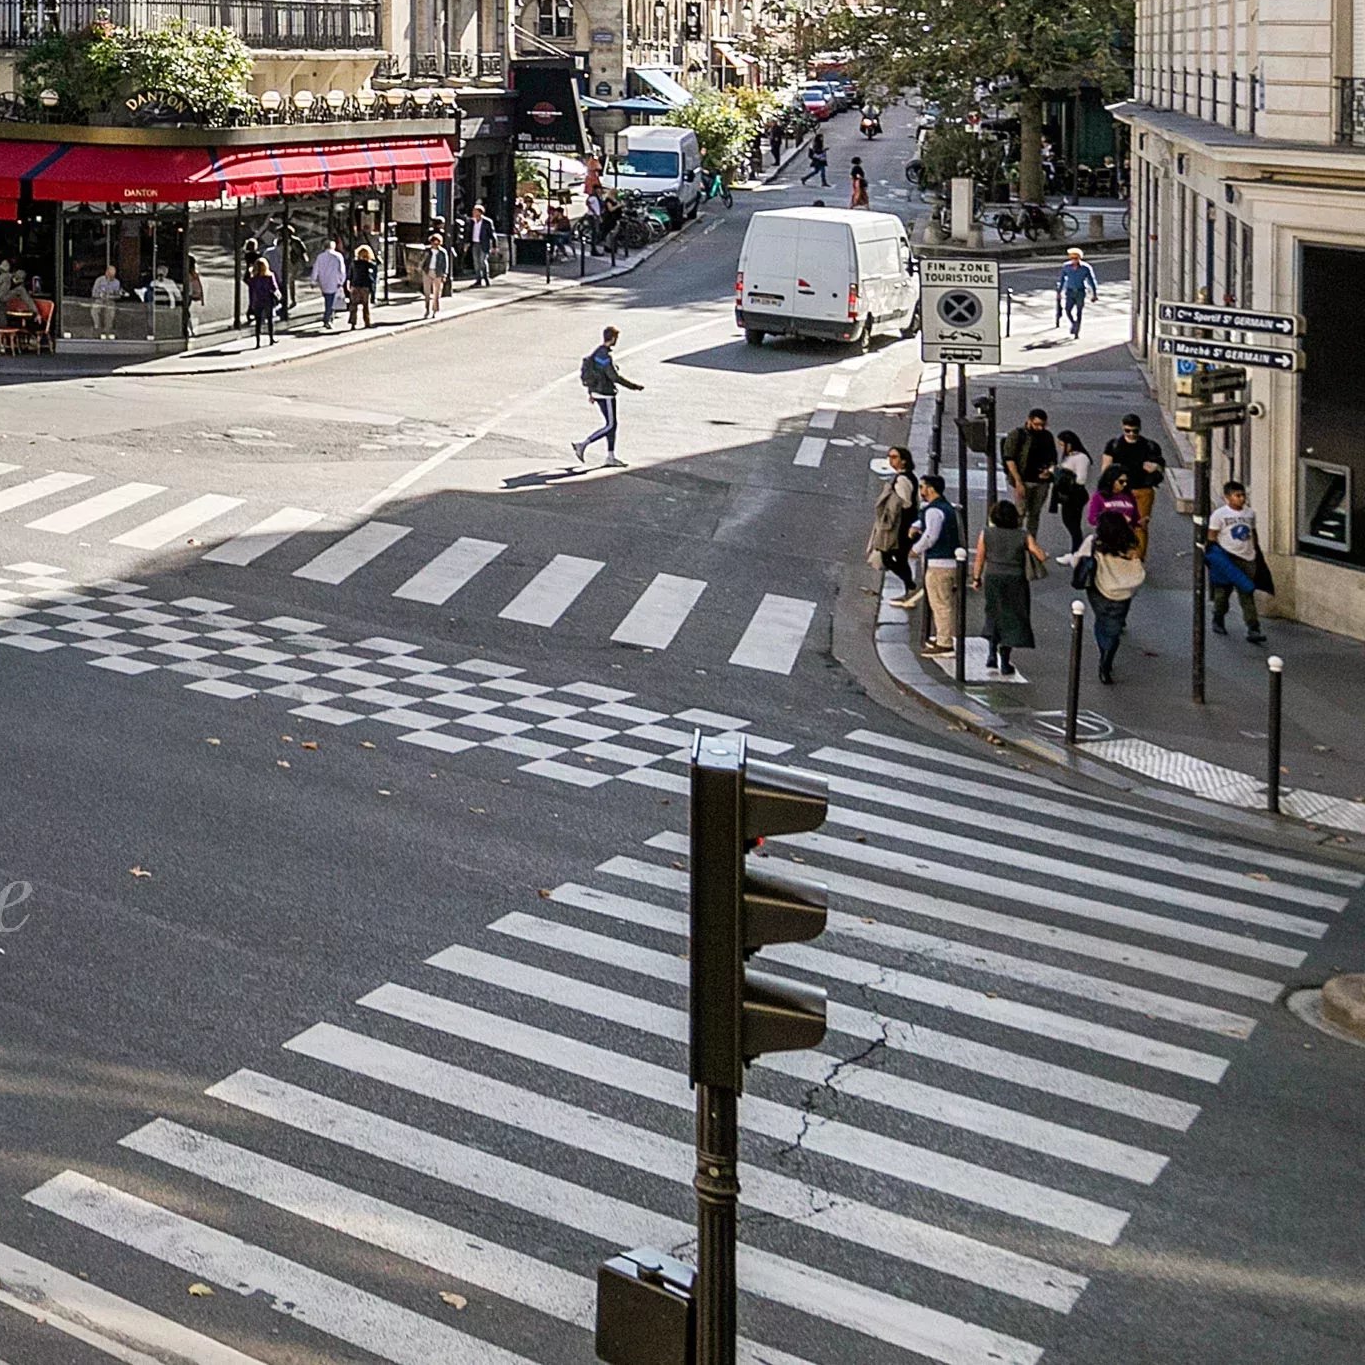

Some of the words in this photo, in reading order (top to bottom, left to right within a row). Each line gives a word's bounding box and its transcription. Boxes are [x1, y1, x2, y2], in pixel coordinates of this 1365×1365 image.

[125, 90, 188, 114] DANTON
[124, 188, 158, 197] DANTON
[927, 262, 946, 271] FIN
[959, 263, 990, 272] ZONE
[924, 273, 995, 283] TOURISTIQUE
[1193, 311, 1222, 322] Sportif
[1233, 316, 1274, 328] GERMAIN
[1176, 343, 1210, 356] Marché
[1224, 349, 1270, 363] GERMAIN
